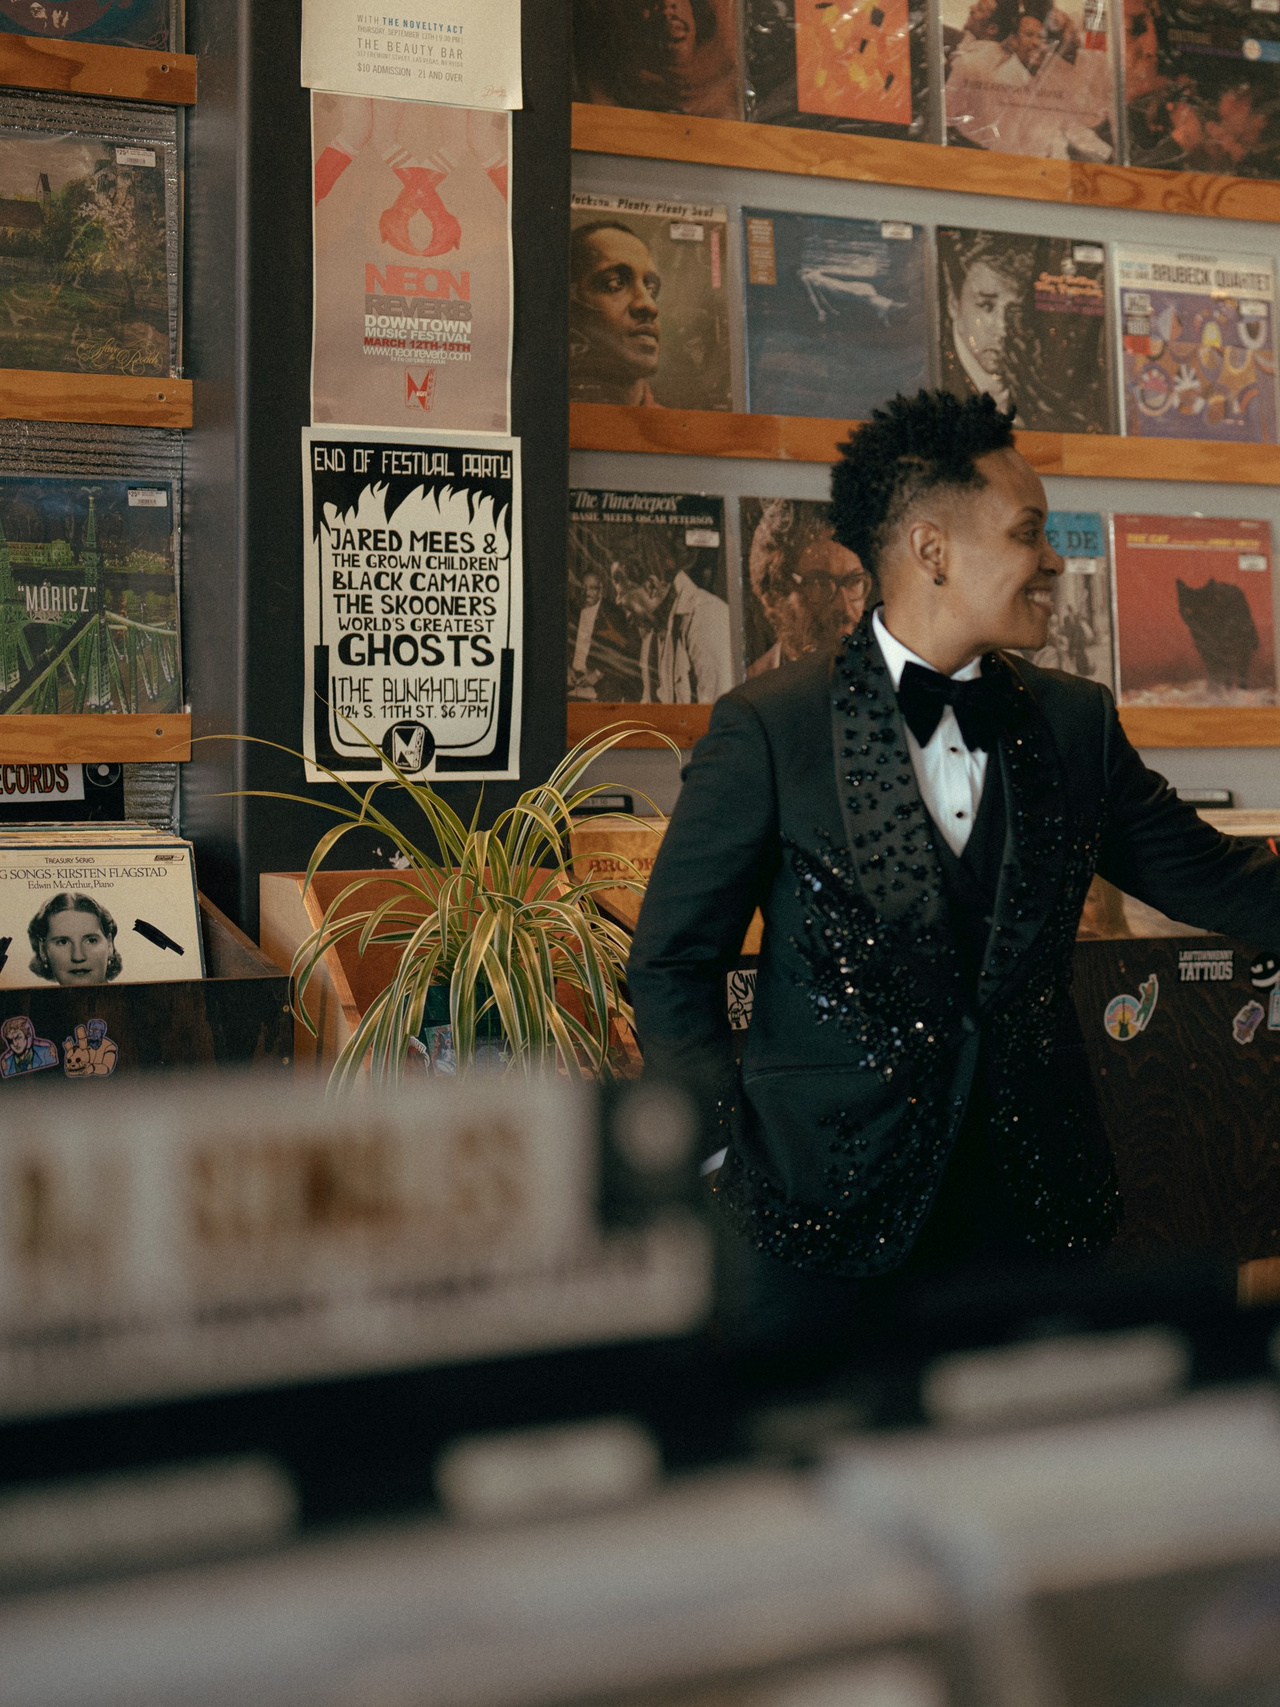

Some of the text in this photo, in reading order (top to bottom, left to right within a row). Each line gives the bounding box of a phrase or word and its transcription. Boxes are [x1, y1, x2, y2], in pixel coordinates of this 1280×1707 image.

[356, 14, 464, 34] WITH THE NOVELTY ACT
[388, 28, 419, 39] SEPTEMBER
[357, 38, 463, 60] THE BEAUTY BAR
[357, 62, 463, 83] $10 ADMISSION 21 AND OVER
[364, 262, 470, 300] NEON
[364, 294, 472, 321] REVERB
[364, 314, 472, 334] DOWNTOWN
[364, 337, 471, 352] MARCH 12TH-15TH
[365, 327, 471, 344] MUSIC FESTIVAL
[362, 346, 472, 361] www.neonreverb.com
[314, 446, 511, 479] END OF FESTIVAL PARTY
[330, 527, 498, 555] JARED MEES &
[332, 553, 498, 571] THE GROWN CHILDREN
[332, 570, 500, 593] BLACK CAMARO
[333, 593, 497, 616] THE SKOONERS
[338, 616, 495, 633] WORLD'S GREATEST
[338, 632, 495, 667] GHOSTS
[338, 676, 490, 704] THE BUNKHOUSE
[364, 705, 376, 719] S.
[380, 704, 412, 719] 11TH
[416, 705, 437, 719] ST.
[441, 704, 456, 719] $6
[460, 705, 488, 719] 7PM
[0, 763, 69, 794] CORDS
[10, 868, 52, 880] SONGS
[57, 868, 107, 879] KIRSTEN
[109, 867, 168, 878] FLAGSTAD
[28, 880, 114, 890] Edwin McArthur, Piano
[1178, 961, 1233, 981] TATTOOS
